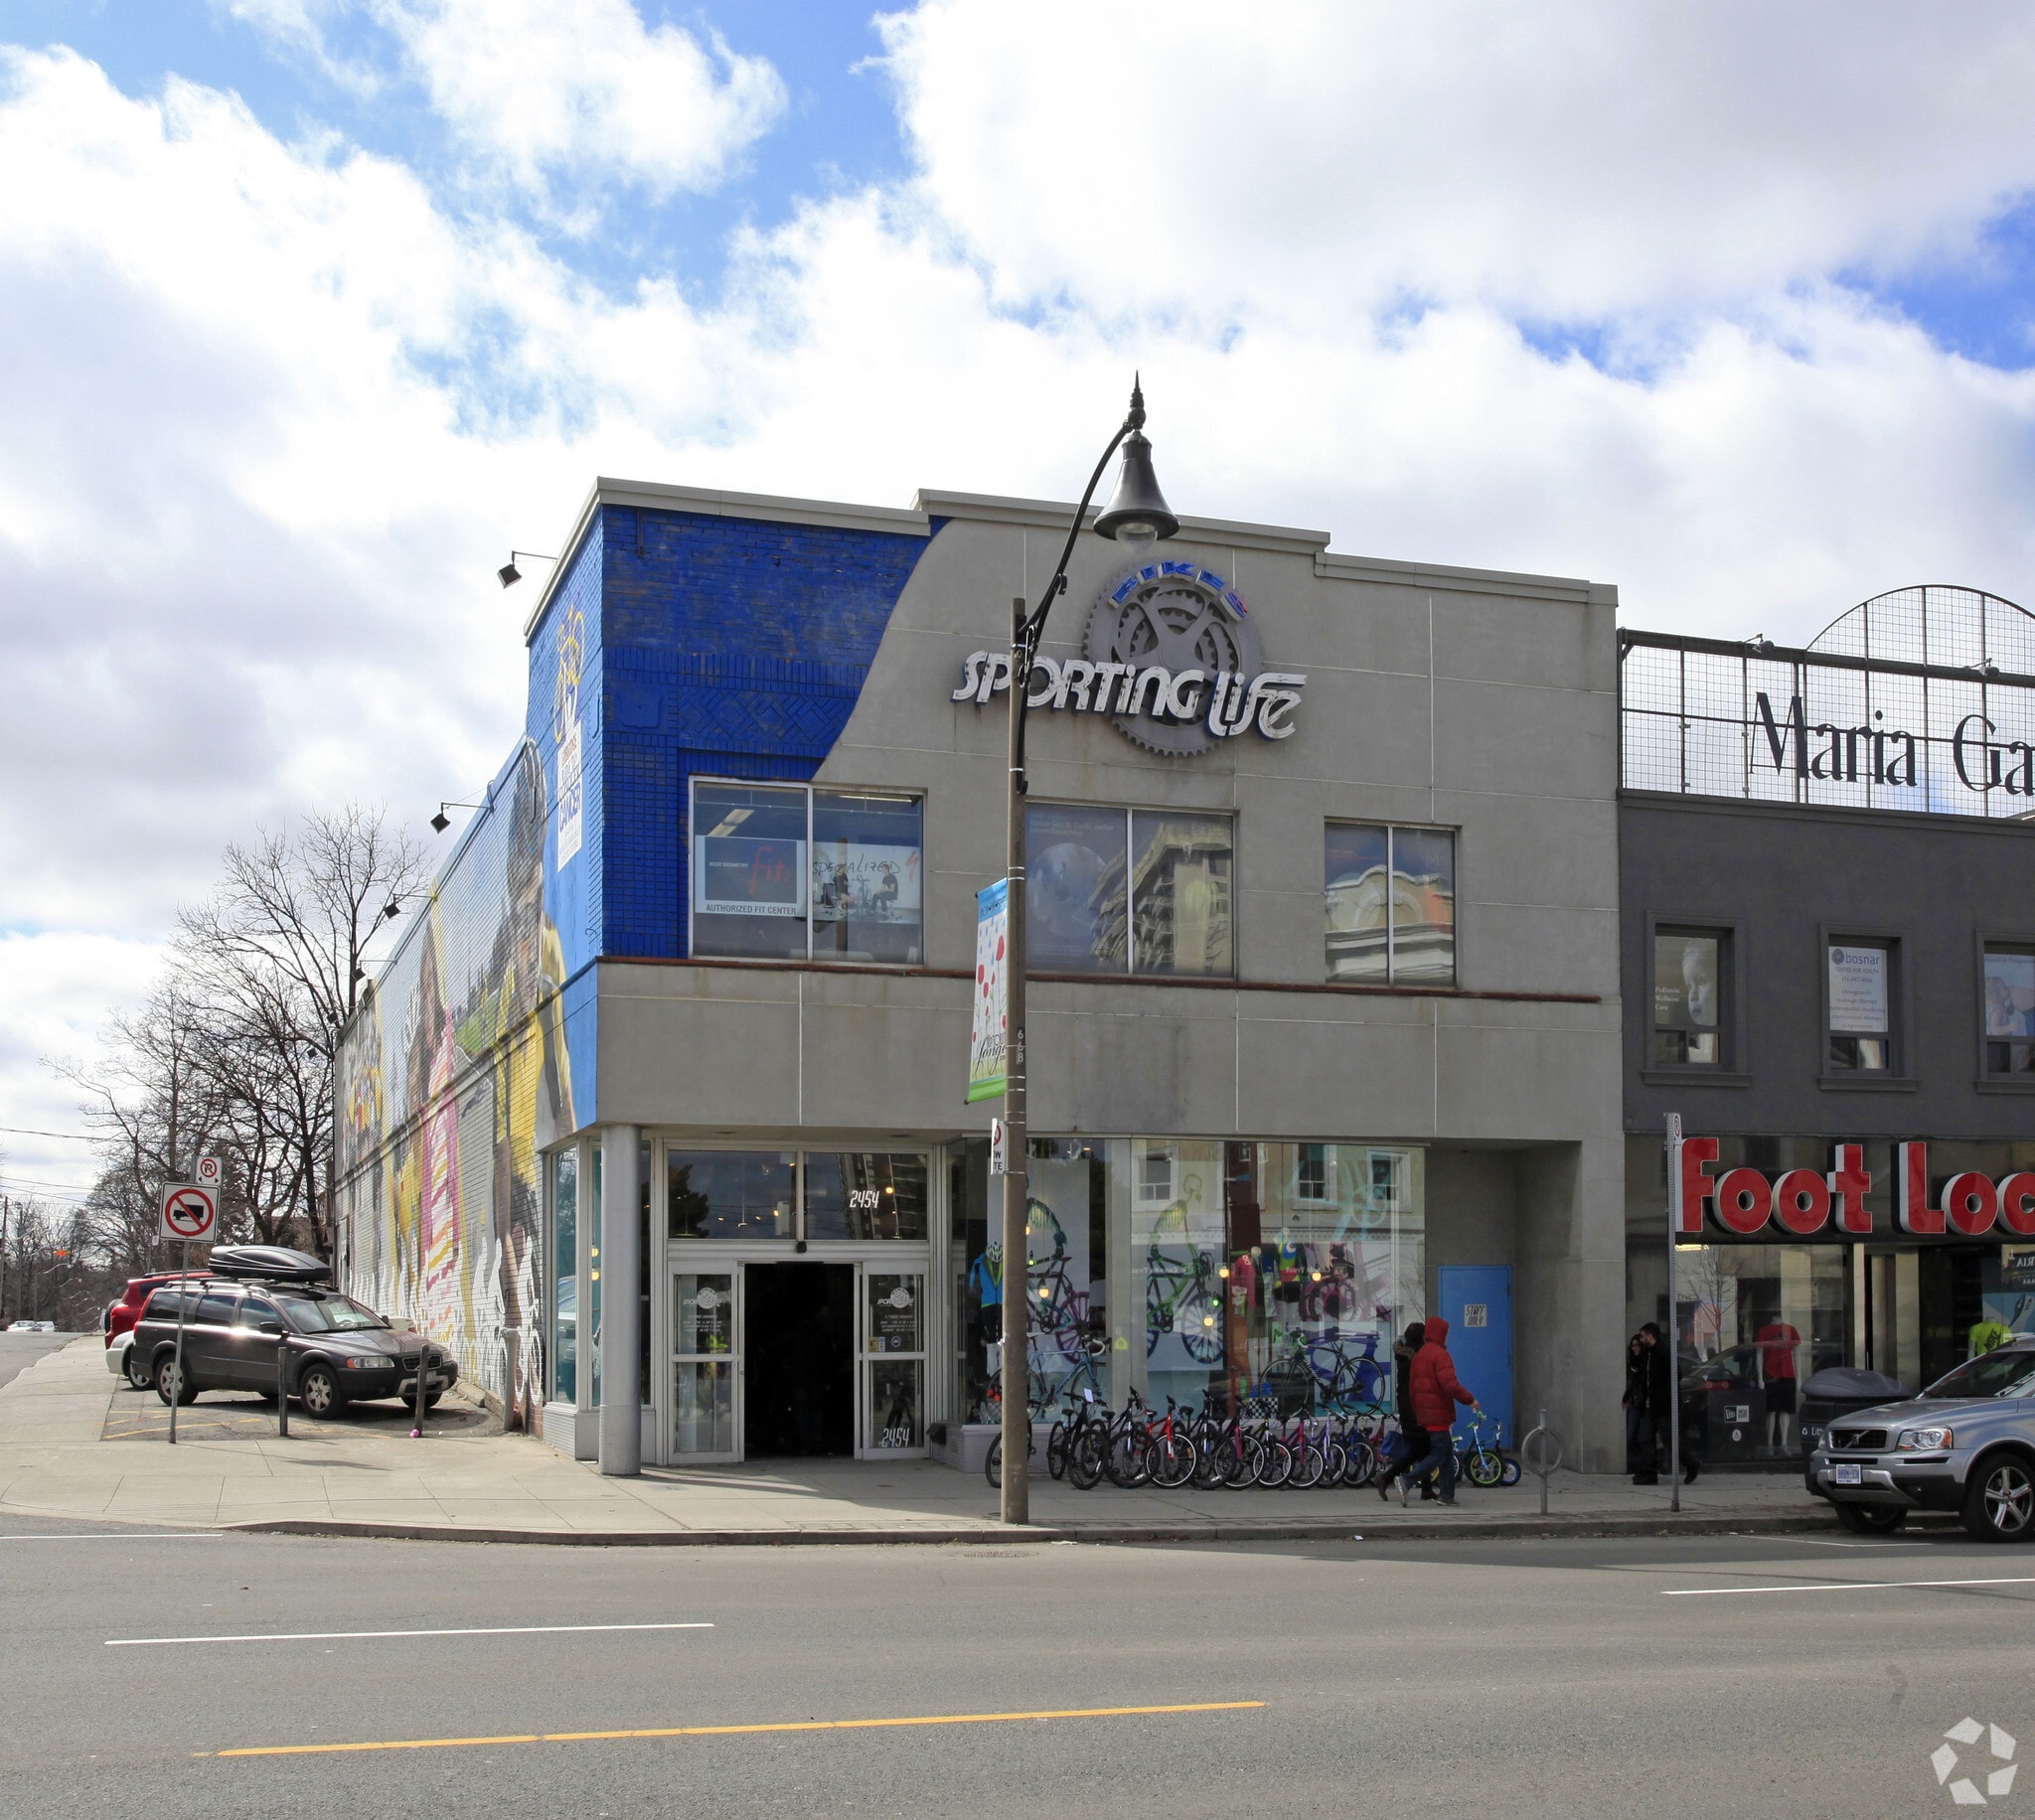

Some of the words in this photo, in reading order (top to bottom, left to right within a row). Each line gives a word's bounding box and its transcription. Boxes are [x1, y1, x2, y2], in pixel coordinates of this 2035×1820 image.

[1107, 559, 1249, 623] BIKES
[1750, 691, 1918, 787] Maria
[1953, 714, 2035, 796] Ga
[705, 903, 753, 914] AUTHORIZED
[754, 905, 766, 914] FIT
[767, 906, 797, 915] CENTER
[1845, 953, 1880, 966] bosnar
[1675, 1137, 1873, 1235] Foot
[850, 1189, 880, 1209] 2454
[881, 1427, 910, 1448] 2454
